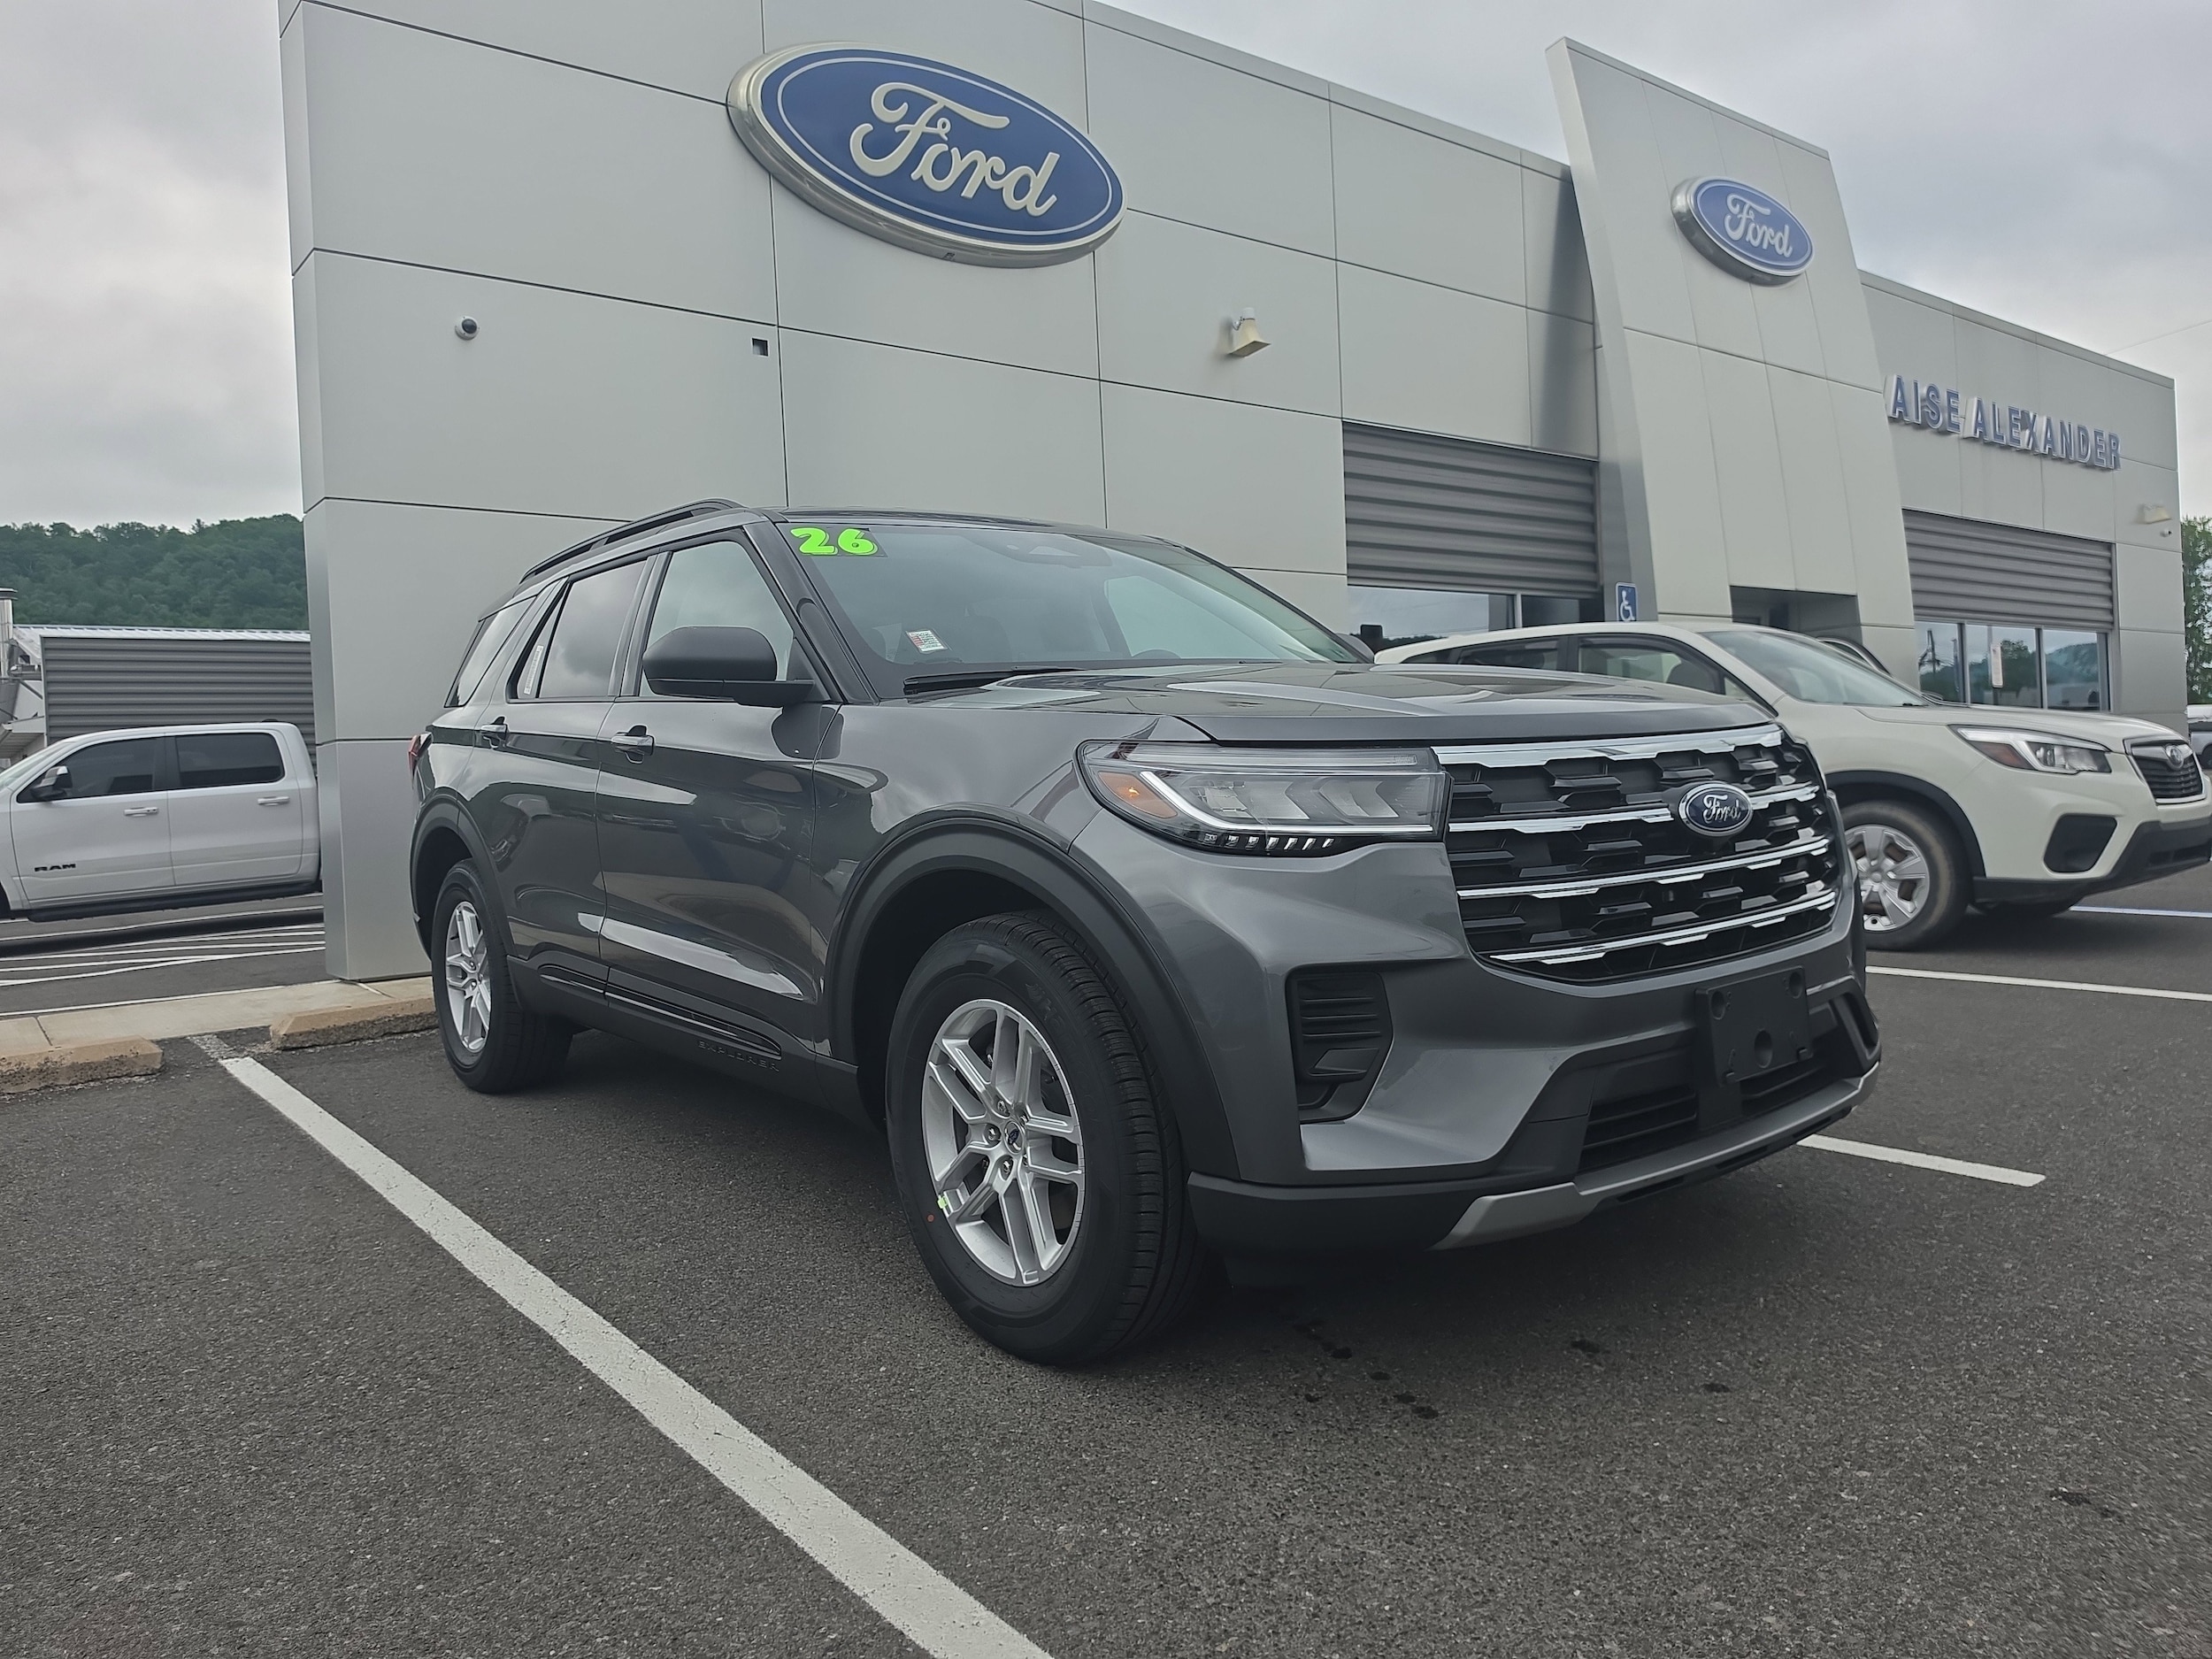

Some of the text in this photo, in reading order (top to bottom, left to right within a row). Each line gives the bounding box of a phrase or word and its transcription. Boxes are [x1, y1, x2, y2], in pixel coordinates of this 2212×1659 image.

[850, 82, 1060, 217] Ford
[1724, 193, 1793, 257] Ford
[1967, 396, 2121, 470] ALEXANDER
[790, 528, 879, 556] 26
[1703, 795, 1741, 823] Ford
[34, 863, 76, 872] RAM
[697, 1041, 779, 1071] EXPLORER
